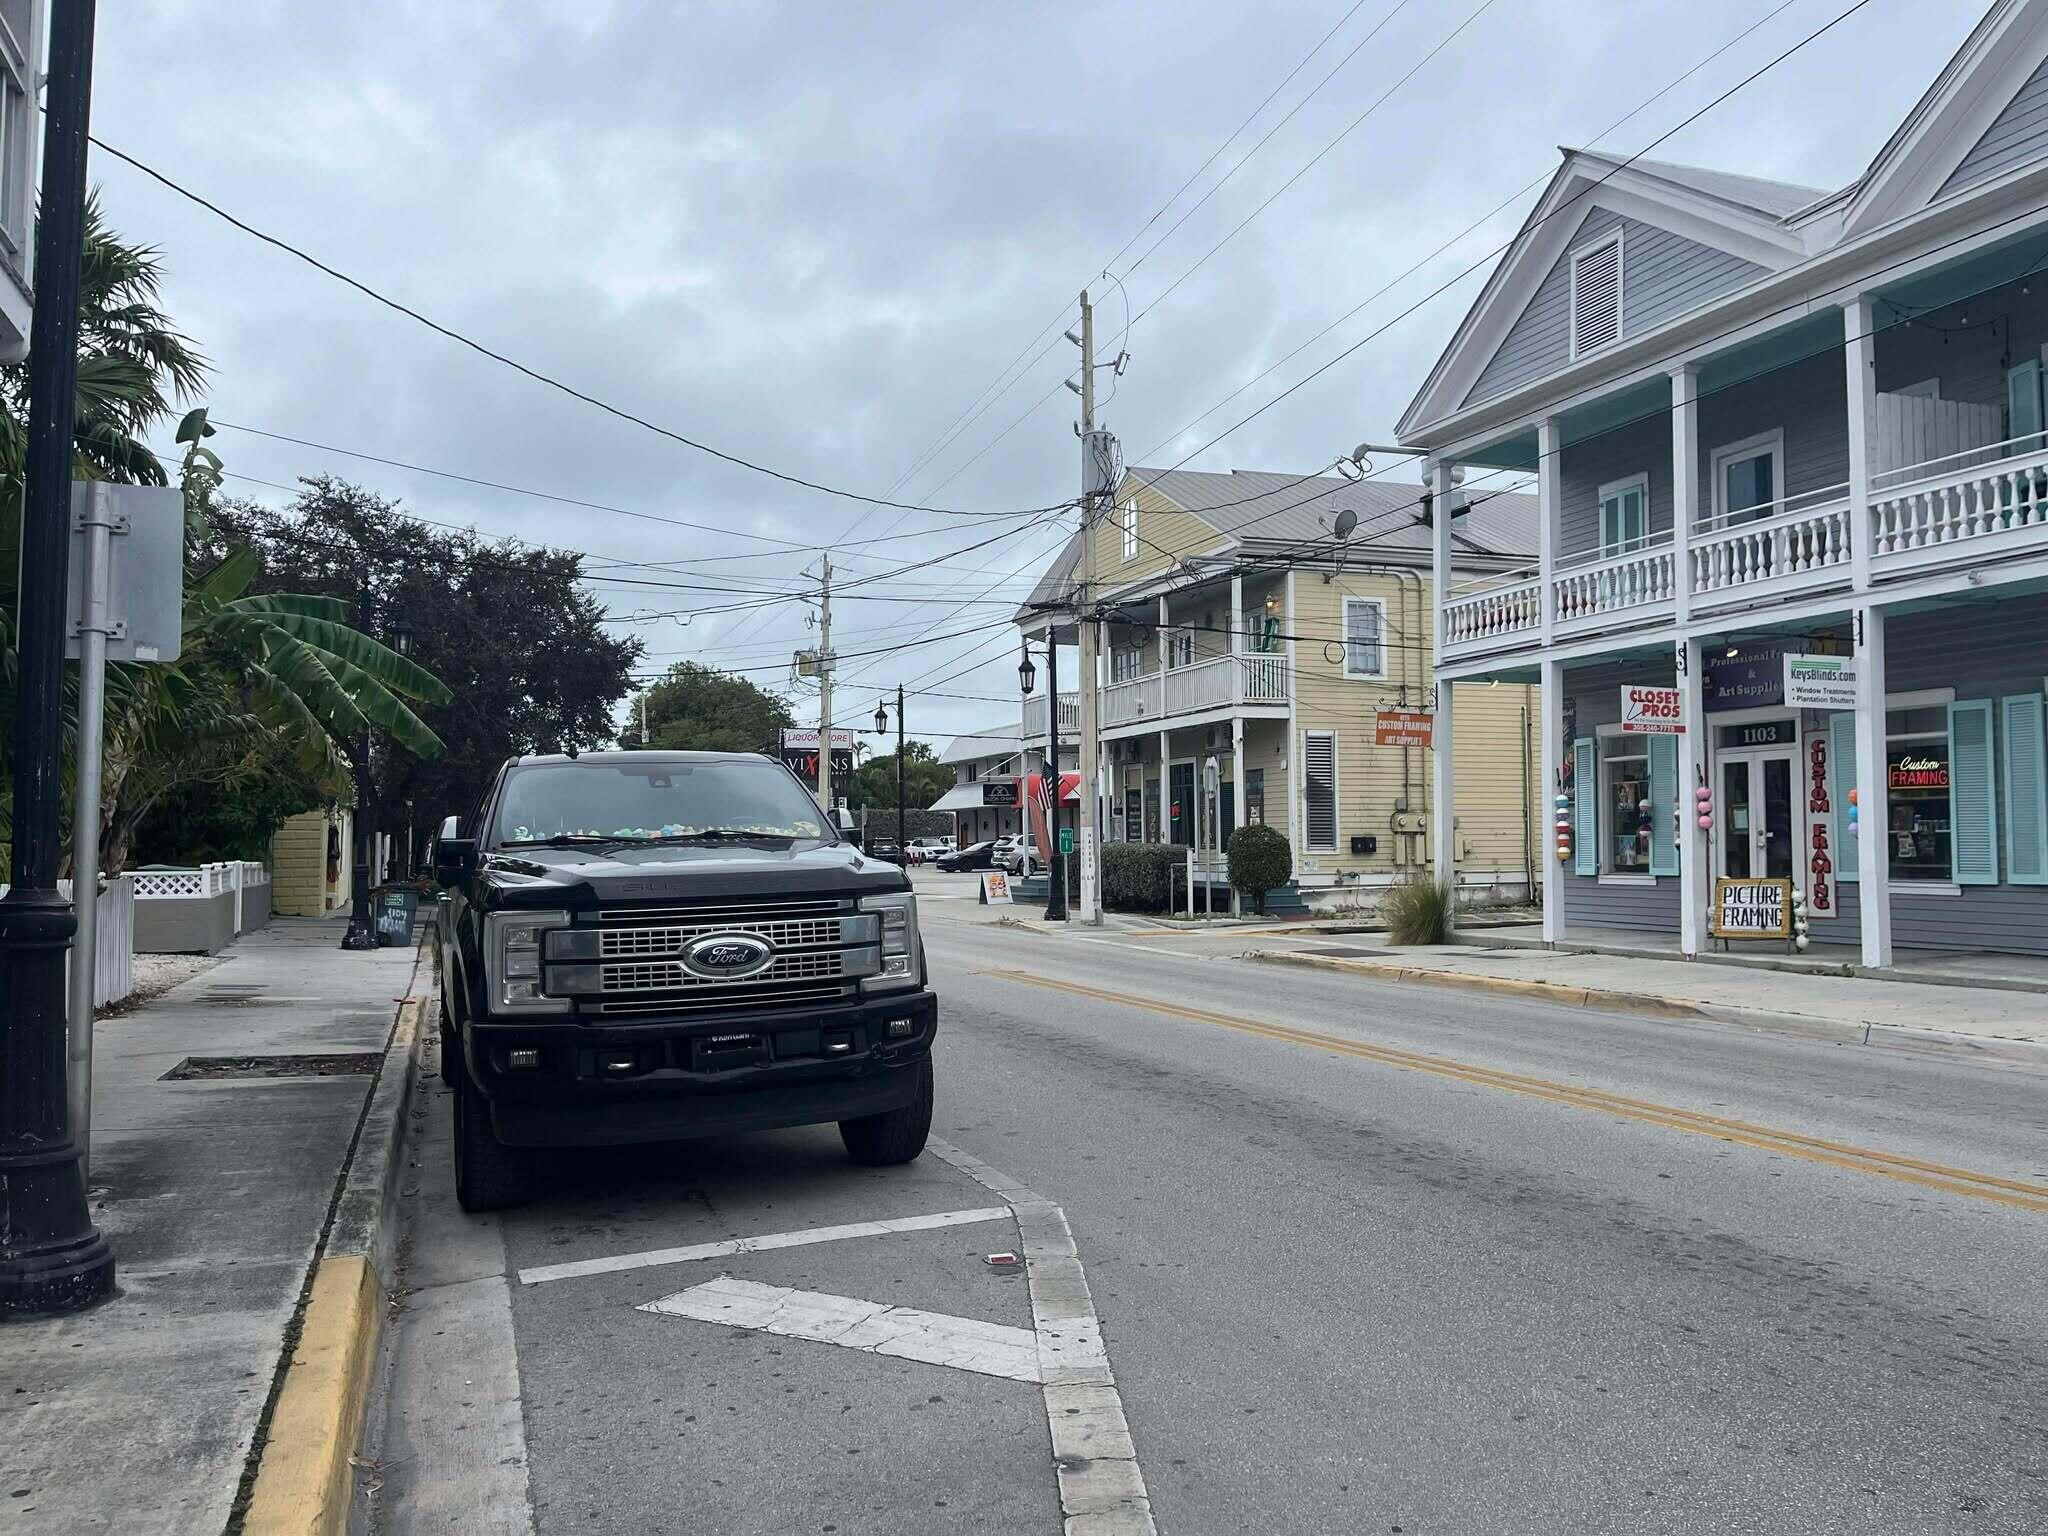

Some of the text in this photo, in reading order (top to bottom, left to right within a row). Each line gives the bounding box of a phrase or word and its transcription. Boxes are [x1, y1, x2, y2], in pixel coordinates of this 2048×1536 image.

[1629, 690, 1680, 705] CLOSET
[1719, 686, 1735, 697] Art
[1823, 687, 1856, 696] Treatments
[1796, 695, 1855, 705] Plantation Shutters
[1642, 703, 1681, 718] PROS
[1378, 719, 1431, 732] CUSTOM FRAMING
[786, 733, 820, 742] LIQUOR
[1384, 735, 1396, 745] ART
[1743, 726, 1777, 743] 1103
[787, 754, 849, 775] VIXNS
[1900, 756, 1940, 771] Custom
[1891, 770, 1949, 786] FRAMING
[1810, 739, 1831, 911] CUSTOM FRAMING
[1722, 885, 1783, 906] PICTURE
[1721, 906, 1783, 928] FRAMING
[708, 946, 749, 964] Ford
